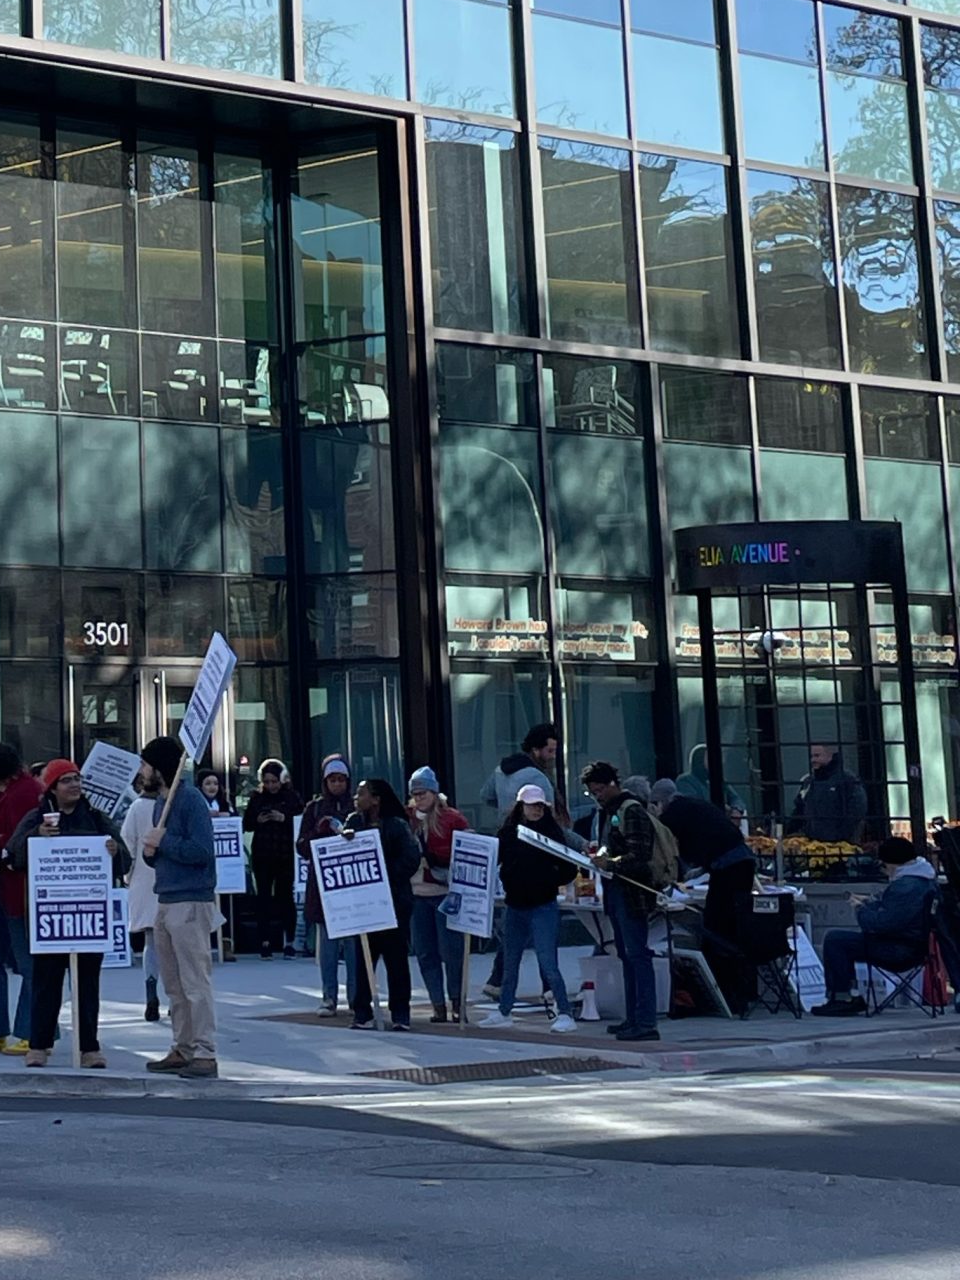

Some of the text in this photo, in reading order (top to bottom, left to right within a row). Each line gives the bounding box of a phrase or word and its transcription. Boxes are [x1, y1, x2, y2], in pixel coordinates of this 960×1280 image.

[731, 543, 789, 564] AVENUE
[83, 621, 129, 646] 3501
[454, 619, 492, 630] Howard
[495, 619, 527, 630] Brown
[528, 619, 546, 631] has
[323, 860, 380, 888] STRIKE
[39, 913, 105, 938] STRIKE
